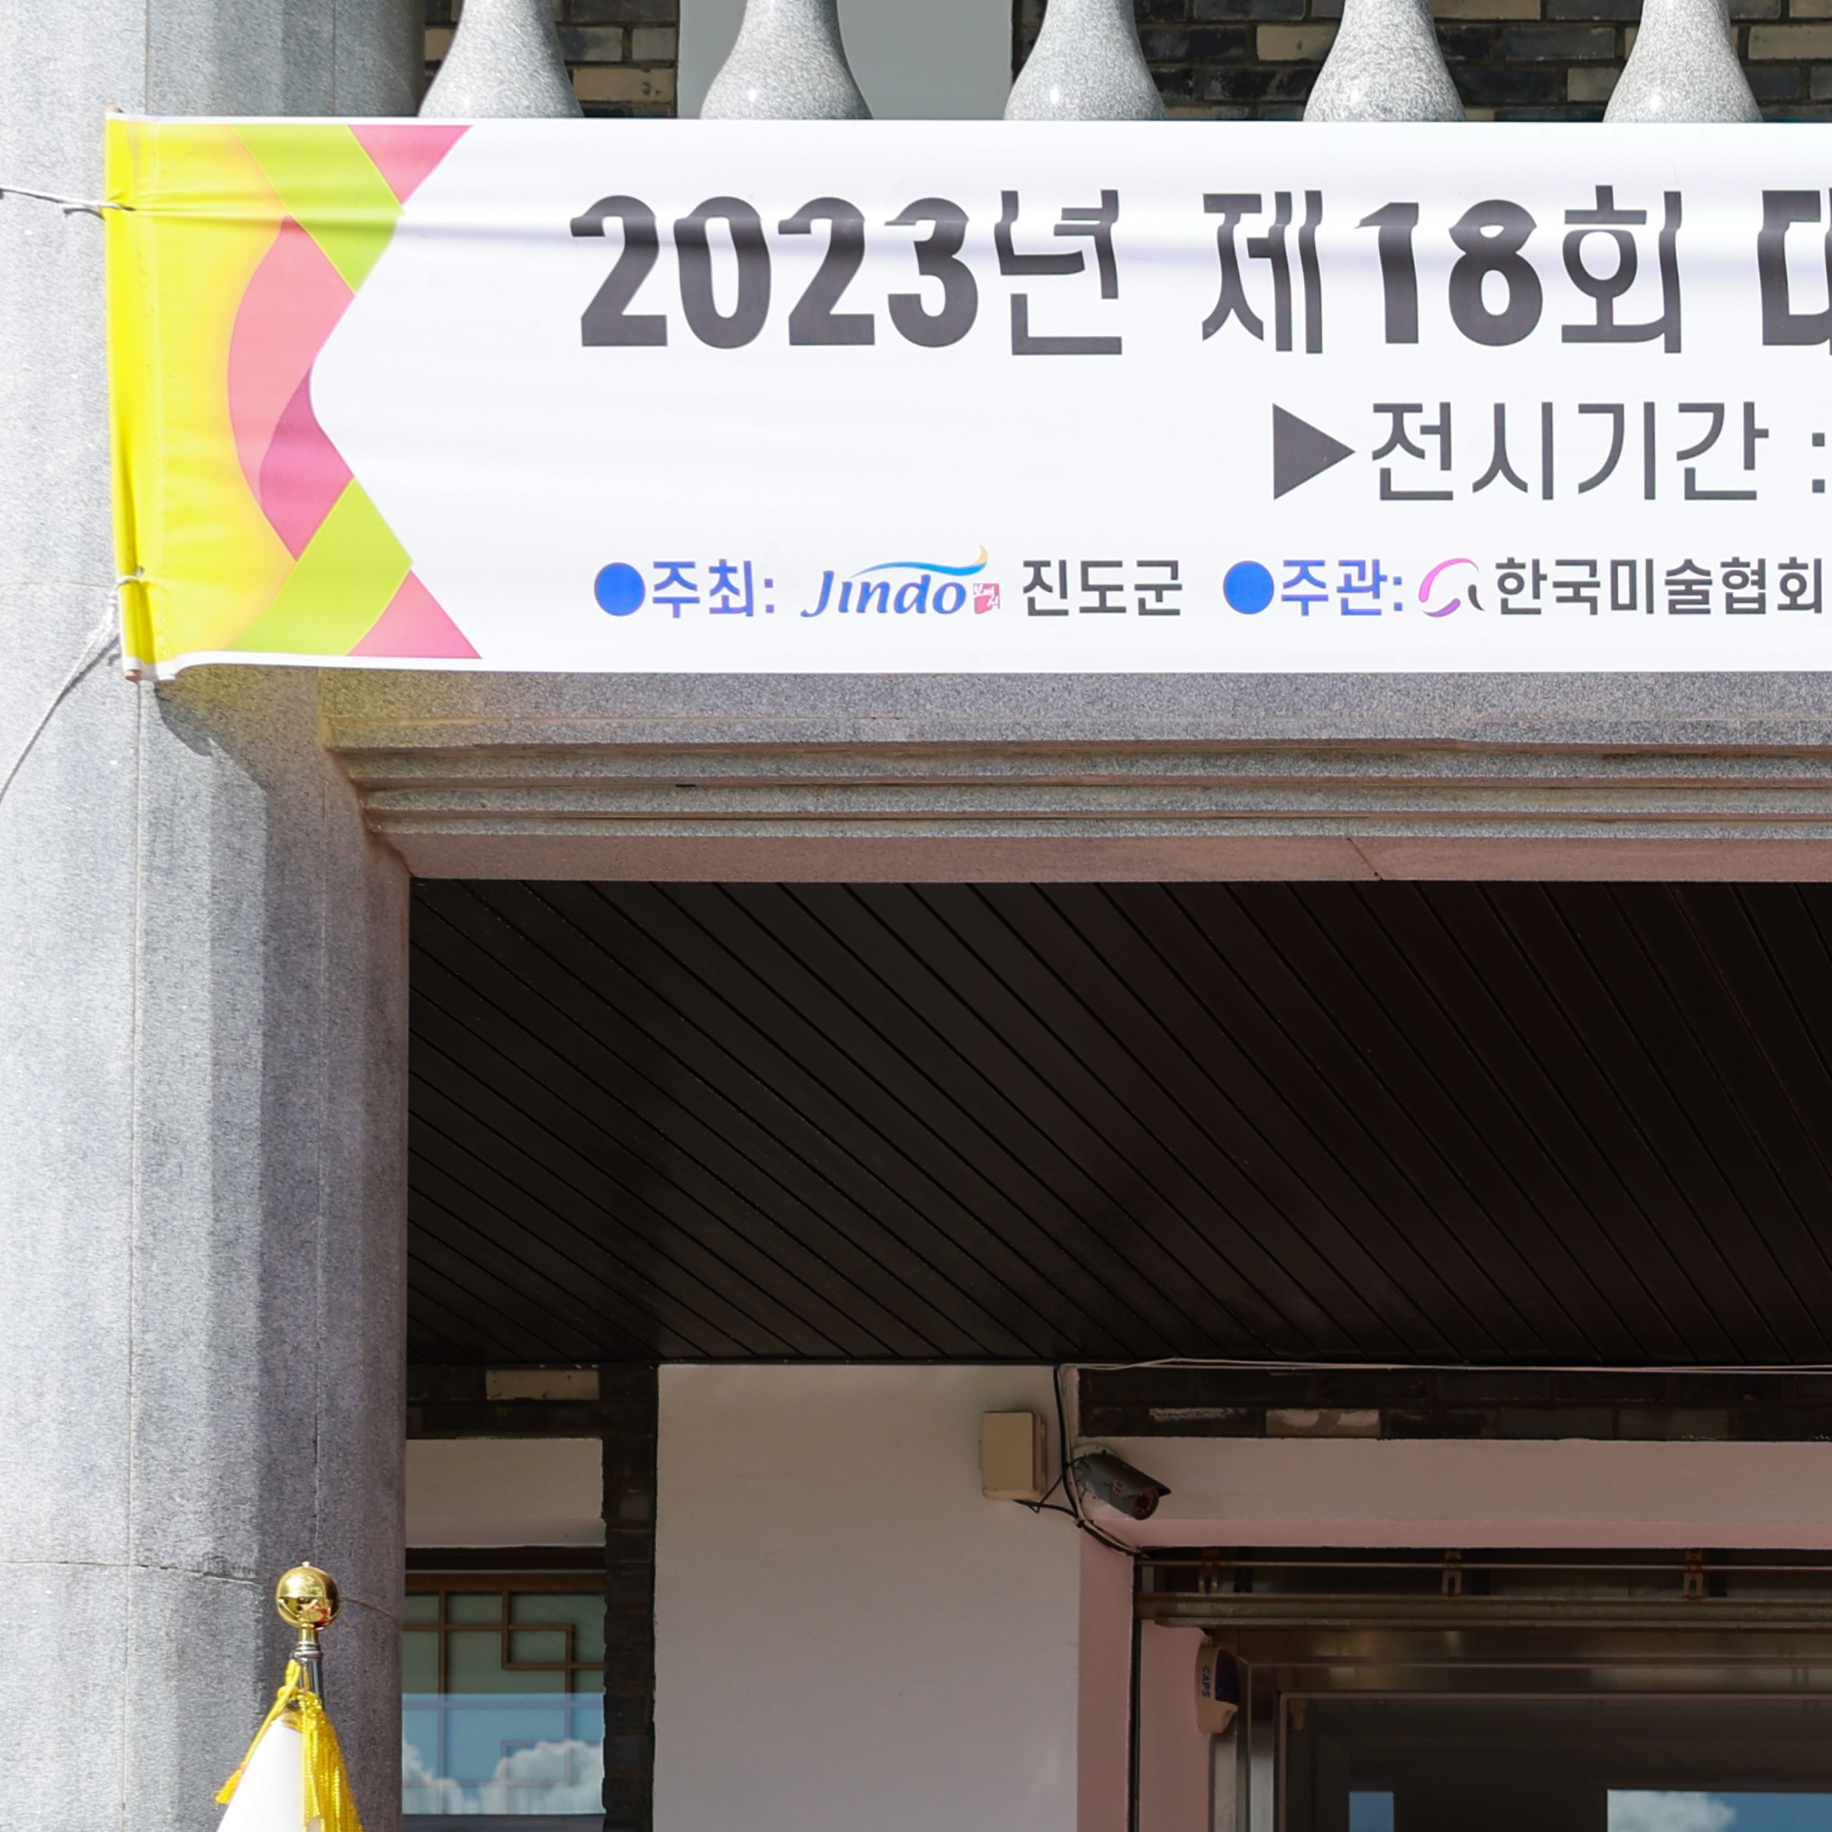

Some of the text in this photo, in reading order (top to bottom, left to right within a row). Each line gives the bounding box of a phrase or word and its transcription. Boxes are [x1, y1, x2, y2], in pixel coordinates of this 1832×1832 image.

[571, 190, 1123, 355] 2023년
[1203, 185, 1682, 354] 제18회
[1373, 402, 1769, 501] 전시기간
[651, 560, 774, 618] 주최:
[802, 568, 968, 619] Jindo
[1023, 560, 1183, 617] 진도군
[1279, 560, 1403, 616] 주관:
[1496, 557, 1823, 616] 한국미술협회
